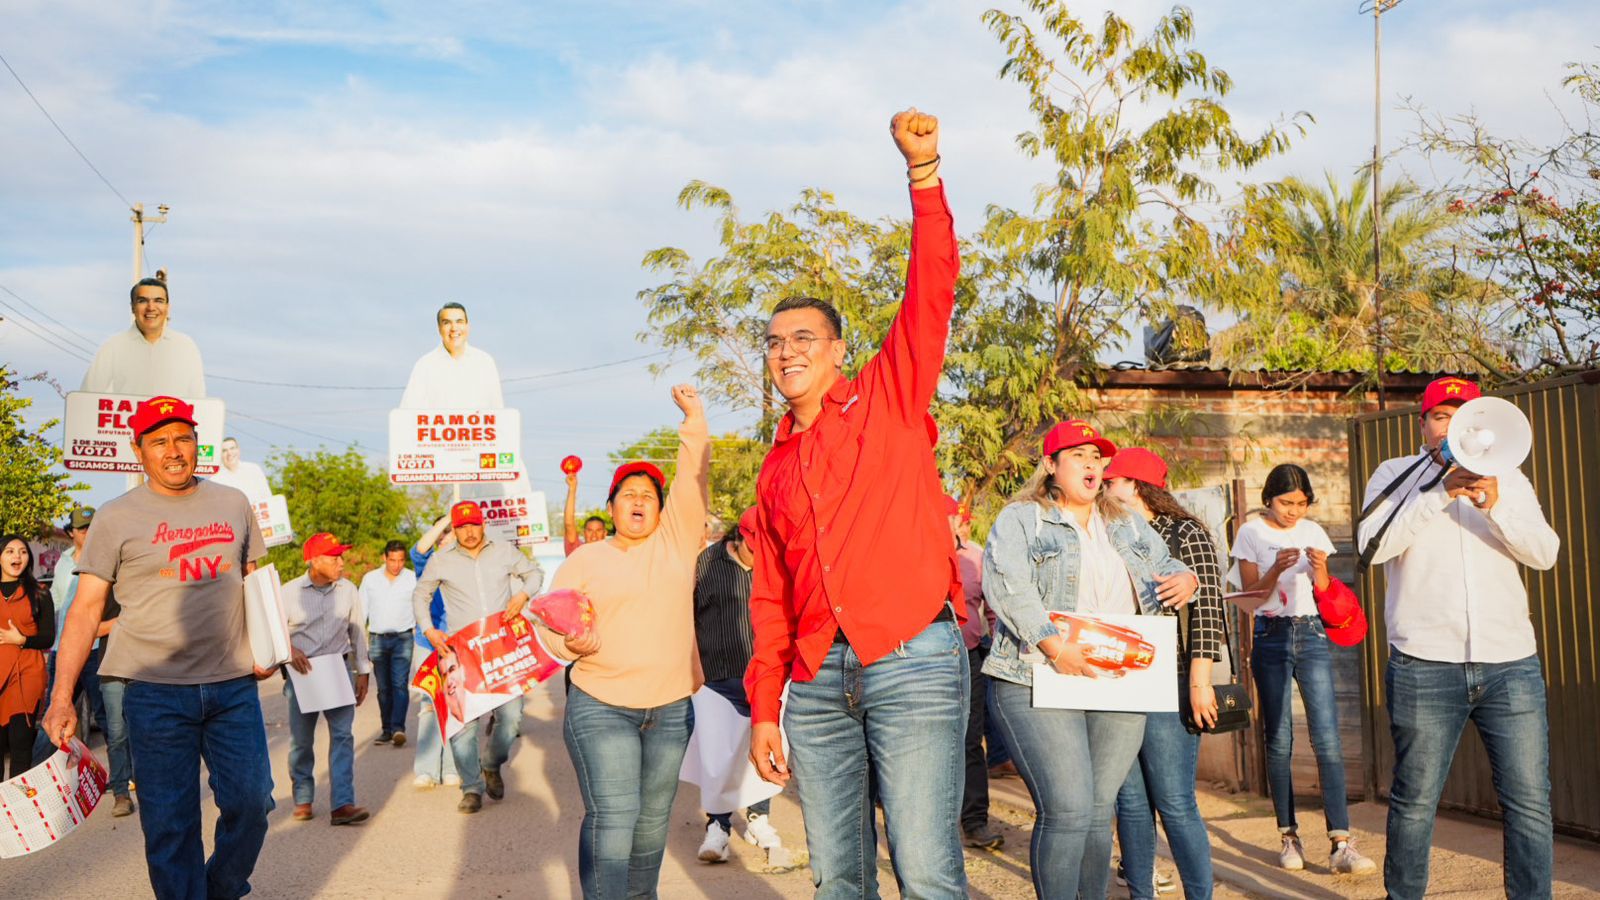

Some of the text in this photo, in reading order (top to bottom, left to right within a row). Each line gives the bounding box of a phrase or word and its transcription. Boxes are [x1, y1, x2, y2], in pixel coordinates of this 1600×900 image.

[417, 410, 495, 425] RAMÓN
[417, 427, 496, 441] FLORES
[92, 439, 117, 447] JUNIO
[75, 446, 113, 456] VOTA
[69, 461, 115, 470] SIGAMOS
[400, 460, 432, 469] VOTA
[396, 472, 516, 482] SIGAMOS HACIENDO HISTORIA
[485, 507, 528, 520] ORES
[179, 555, 223, 582] NY
[481, 645, 532, 674] RAMÓN
[485, 655, 538, 684] FLORES
